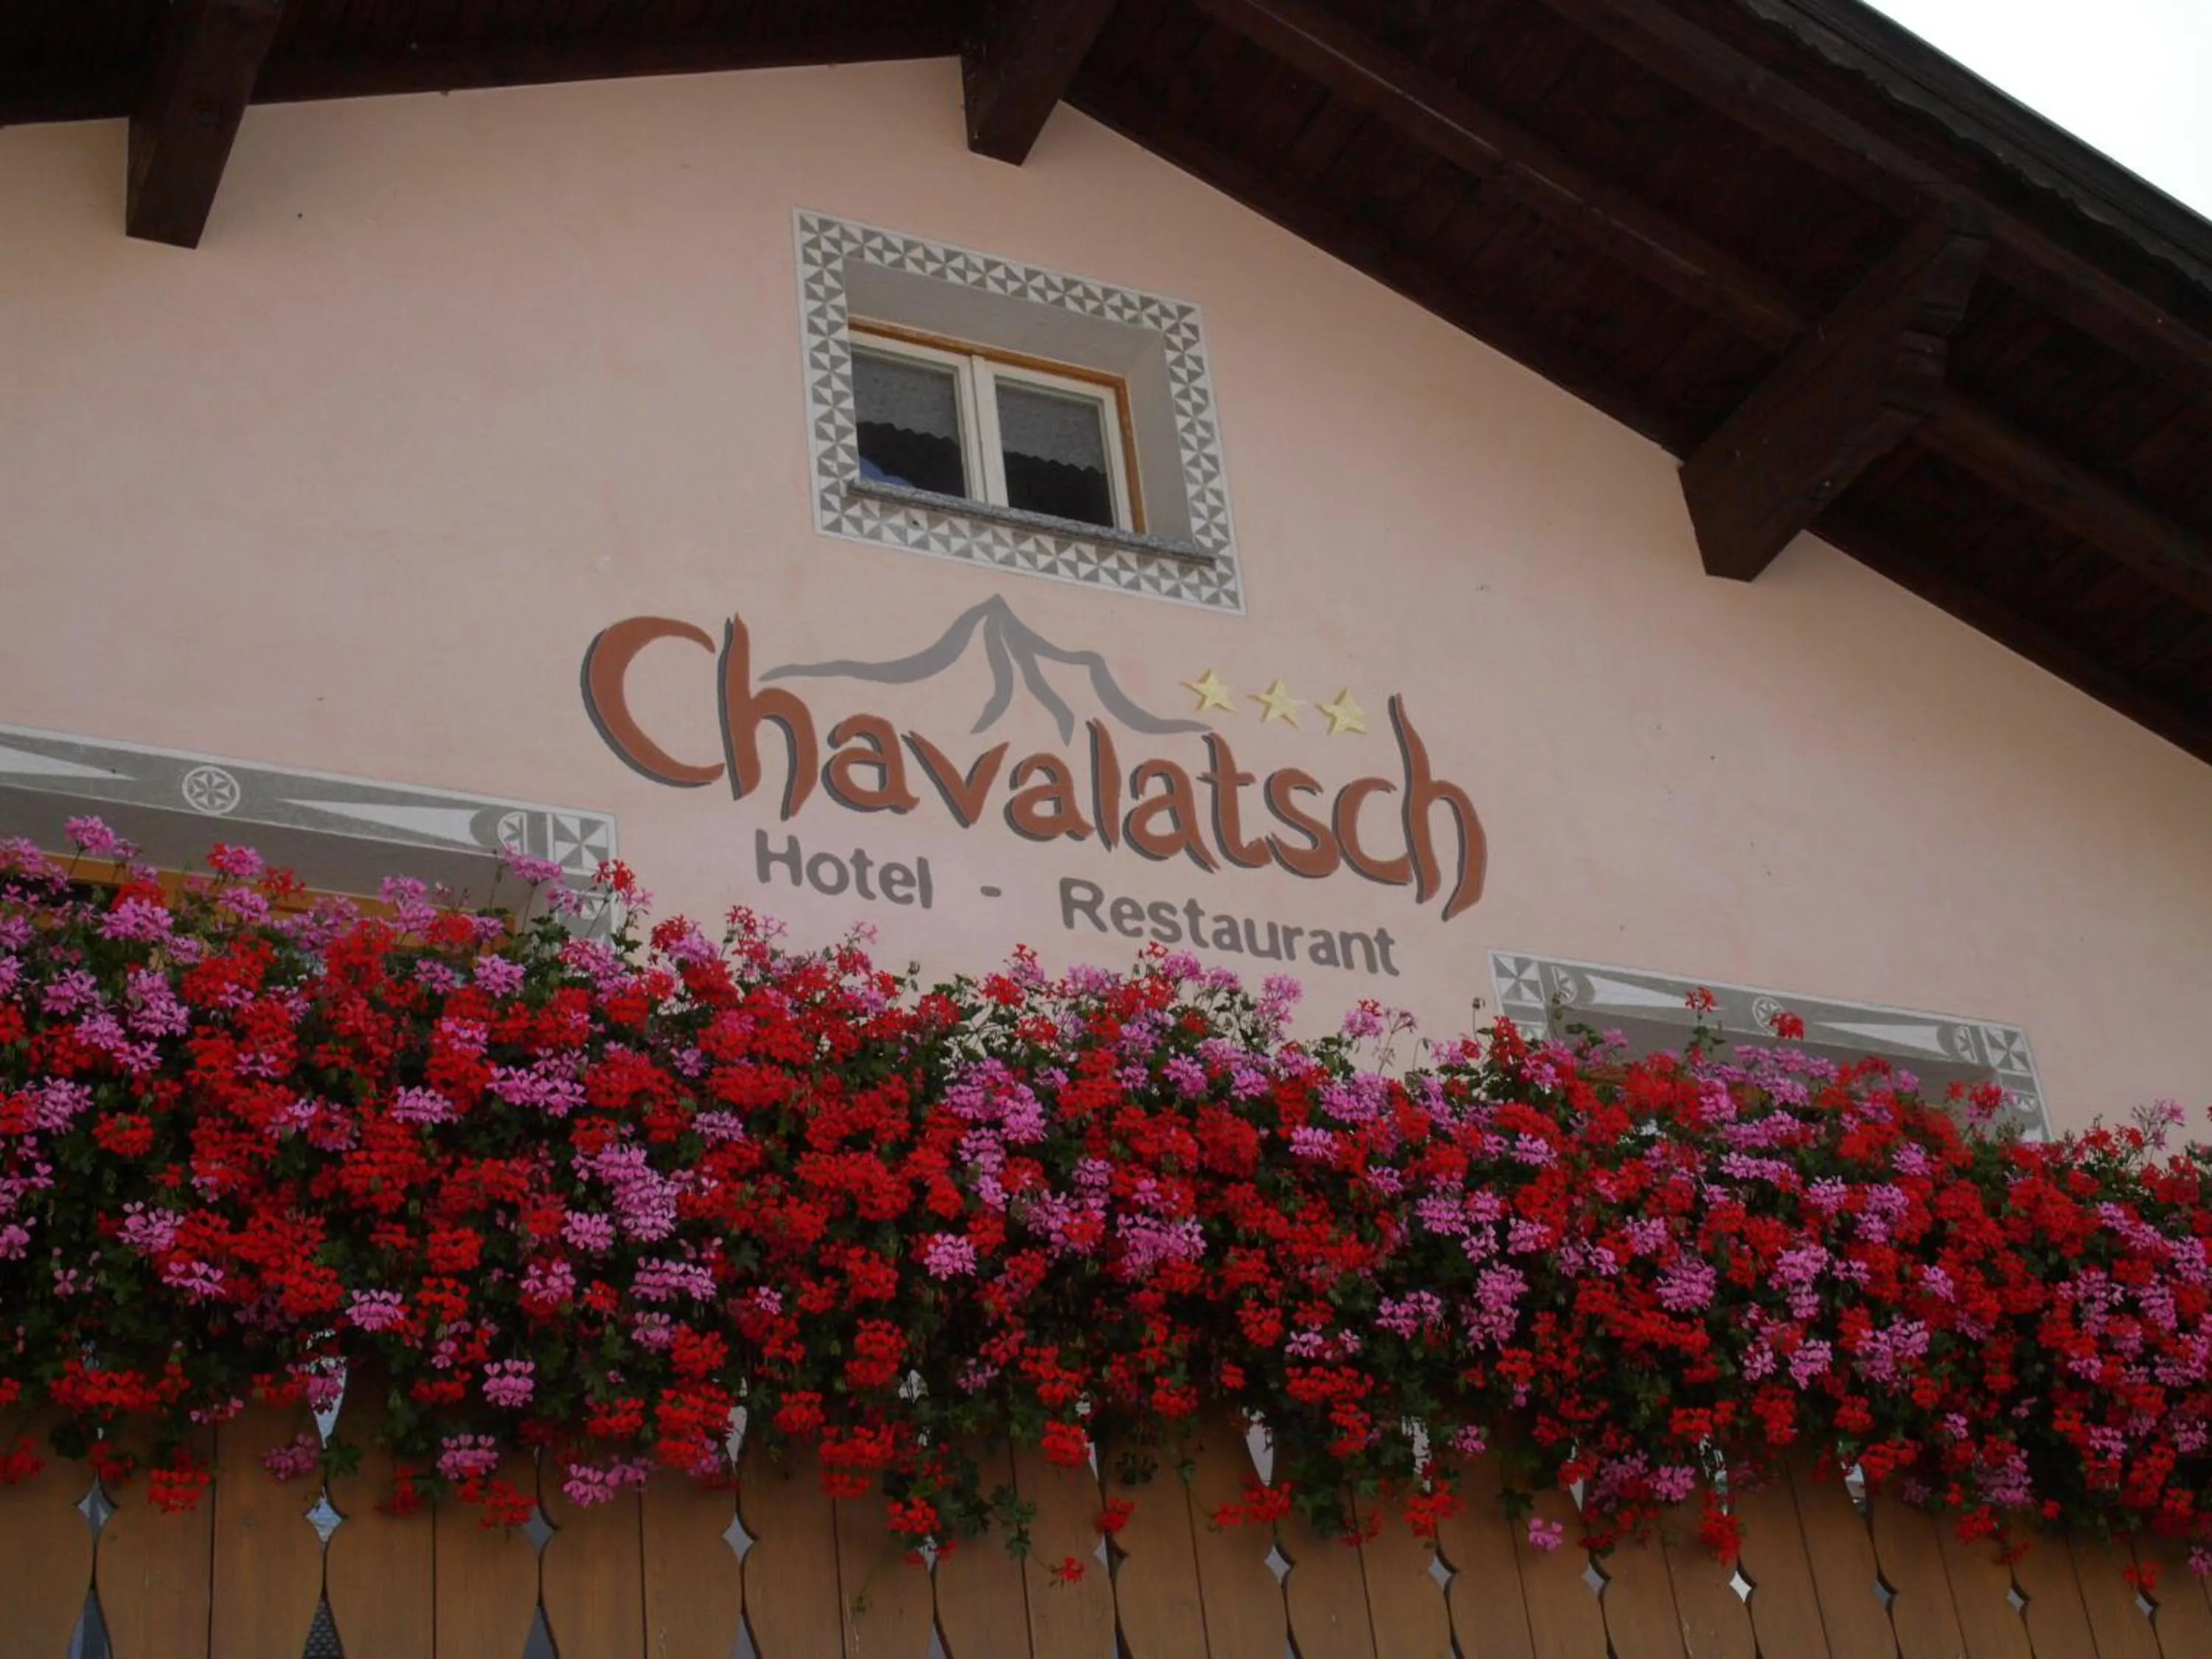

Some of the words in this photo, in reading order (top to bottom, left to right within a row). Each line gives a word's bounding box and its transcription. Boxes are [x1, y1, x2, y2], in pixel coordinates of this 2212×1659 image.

[581, 613, 1486, 920] Chavalatsch
[755, 828, 933, 908] Hotel
[1060, 877, 1399, 975] Restaurant
